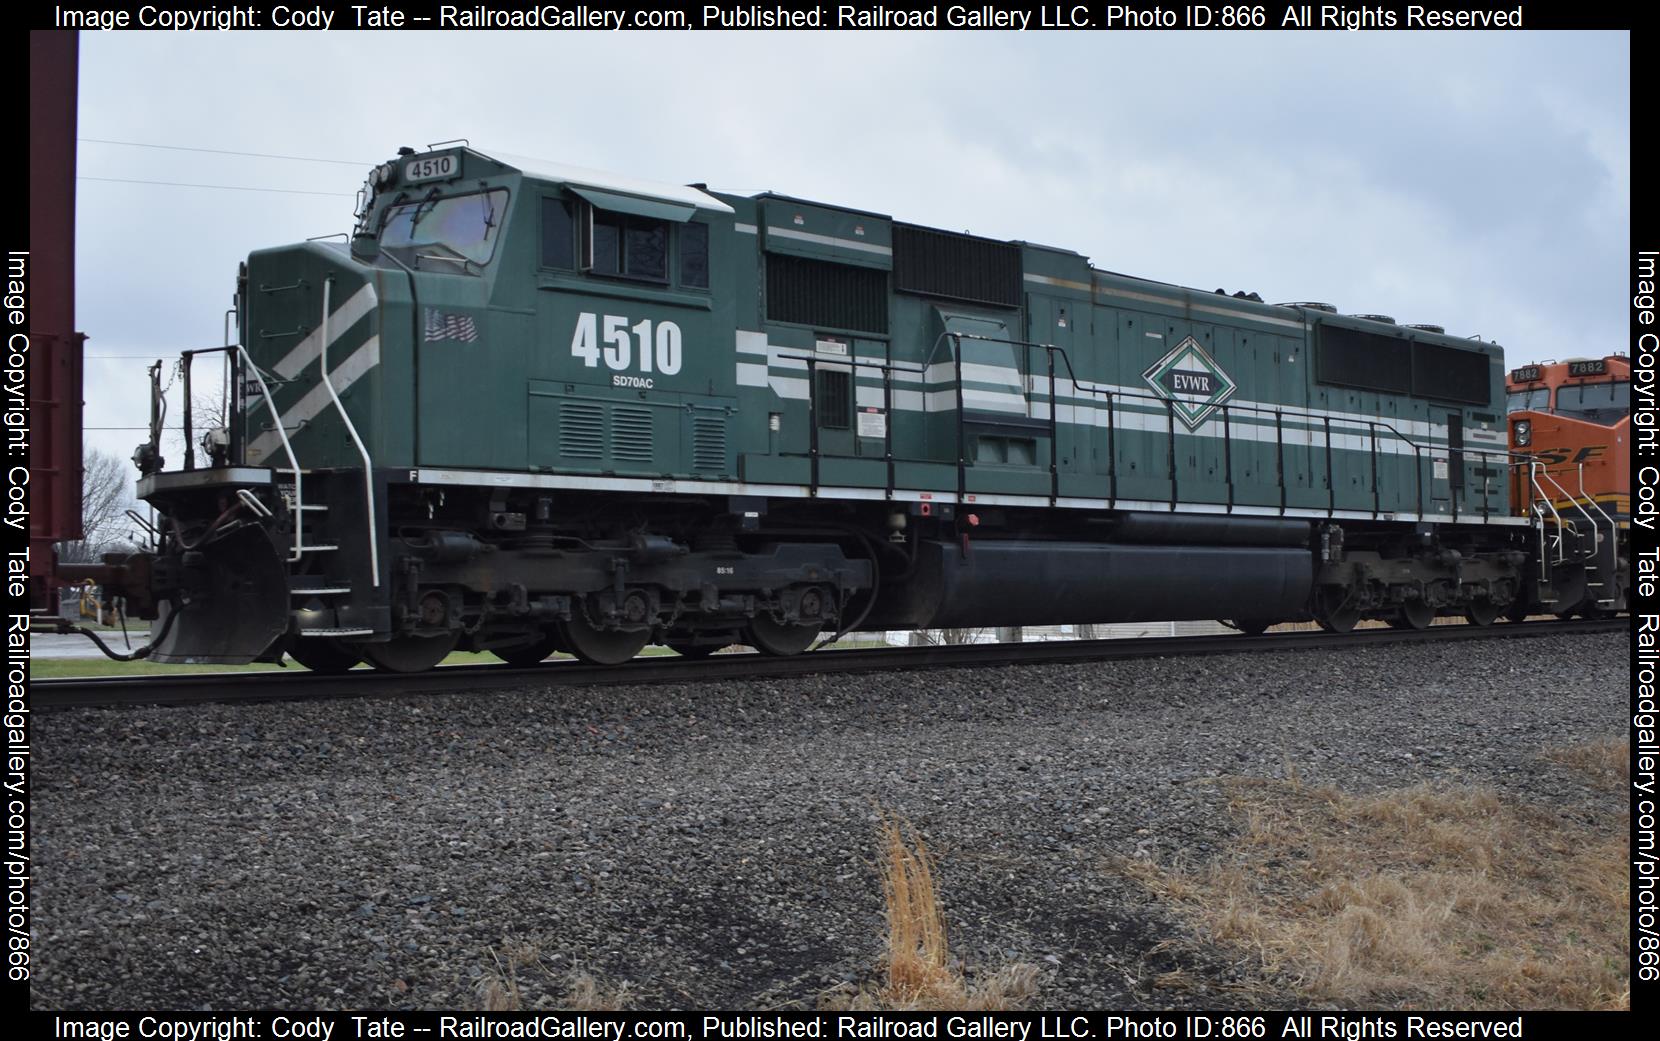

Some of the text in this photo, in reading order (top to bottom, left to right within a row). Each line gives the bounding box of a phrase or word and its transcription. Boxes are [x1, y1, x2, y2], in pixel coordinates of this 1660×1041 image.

[412, 158, 450, 178] 4510
[571, 312, 682, 376] 4510
[1514, 368, 1537, 380] 7882
[1572, 361, 1603, 374] 7882
[613, 376, 654, 389] SD70AC
[1173, 374, 1210, 392] EVWR
[409, 470, 418, 482] F
